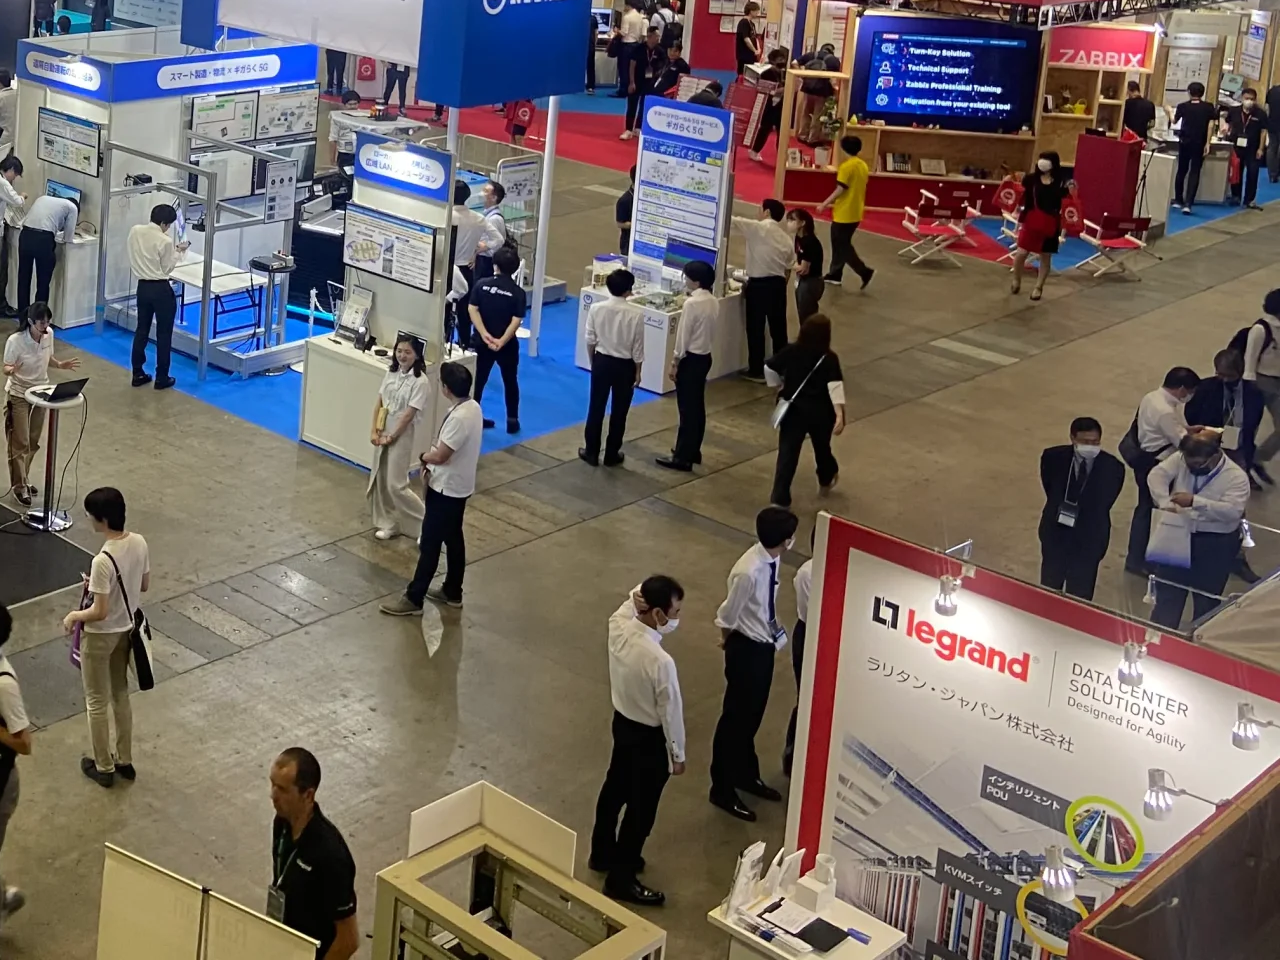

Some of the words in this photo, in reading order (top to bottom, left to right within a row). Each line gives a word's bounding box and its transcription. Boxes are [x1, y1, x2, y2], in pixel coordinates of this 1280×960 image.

[910, 48, 940, 57] Turn-Key
[942, 50, 971, 58] Solution
[1059, 50, 1142, 68] ZABBIX
[170, 67, 226, 82] スマート製造・物流
[234, 64, 257, 74] ギガらく
[259, 62, 269, 72] 5G
[908, 64, 940, 73] Technical
[942, 66, 969, 75] Support
[906, 81, 930, 89] Zabbix
[930, 82, 972, 91] Professional
[974, 85, 1002, 94] Training
[904, 98, 935, 107] Migration
[936, 99, 952, 107] from
[953, 101, 969, 109] your
[970, 102, 996, 110] existing
[666, 121, 704, 136] ギガらく5G
[660, 145, 702, 162] ギガらく5G
[906, 608, 1030, 684] legrand
[1072, 662, 1113, 691] DATA
[1118, 682, 1189, 718] CENTER
[867, 656, 1075, 754] ラリタン・ジャパン株式会社
[1070, 680, 1166, 727] SOLUTIONS
[1067, 697, 1124, 730] Designed
[1126, 716, 1143, 735] for
[1146, 725, 1186, 752] Agility
[986, 785, 1009, 803] PDU
[987, 774, 1061, 810] インテリジェント
[943, 862, 1003, 896] KVMスイッチ
